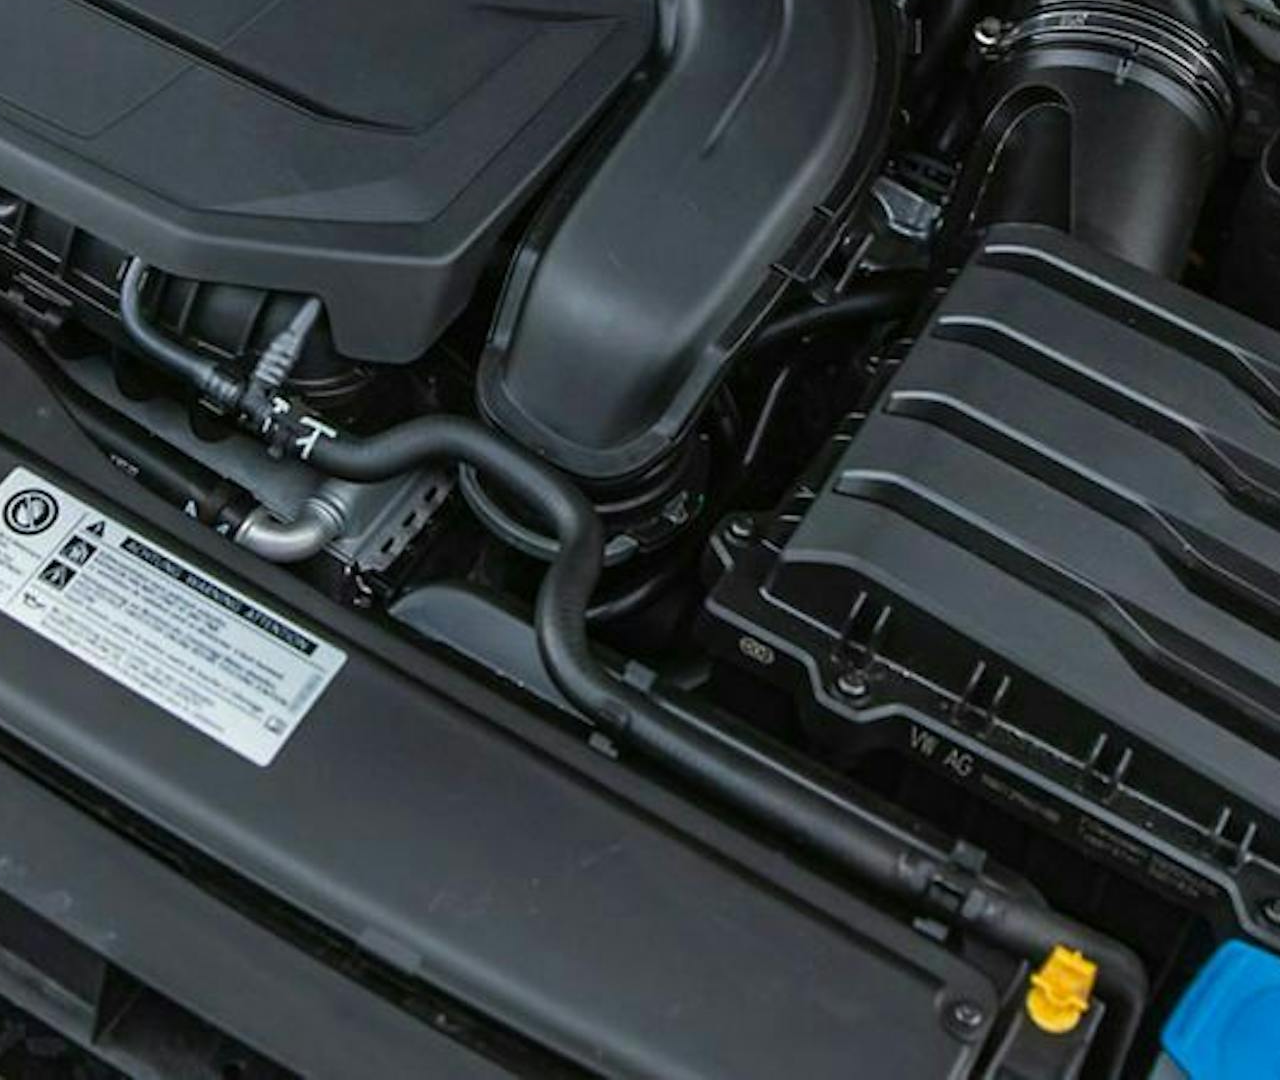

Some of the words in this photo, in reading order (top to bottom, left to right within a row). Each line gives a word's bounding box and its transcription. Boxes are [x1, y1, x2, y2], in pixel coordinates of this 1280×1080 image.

[185, 572, 245, 612] WARNING
[245, 606, 313, 655] ATTENTION
[942, 748, 975, 777] AG
